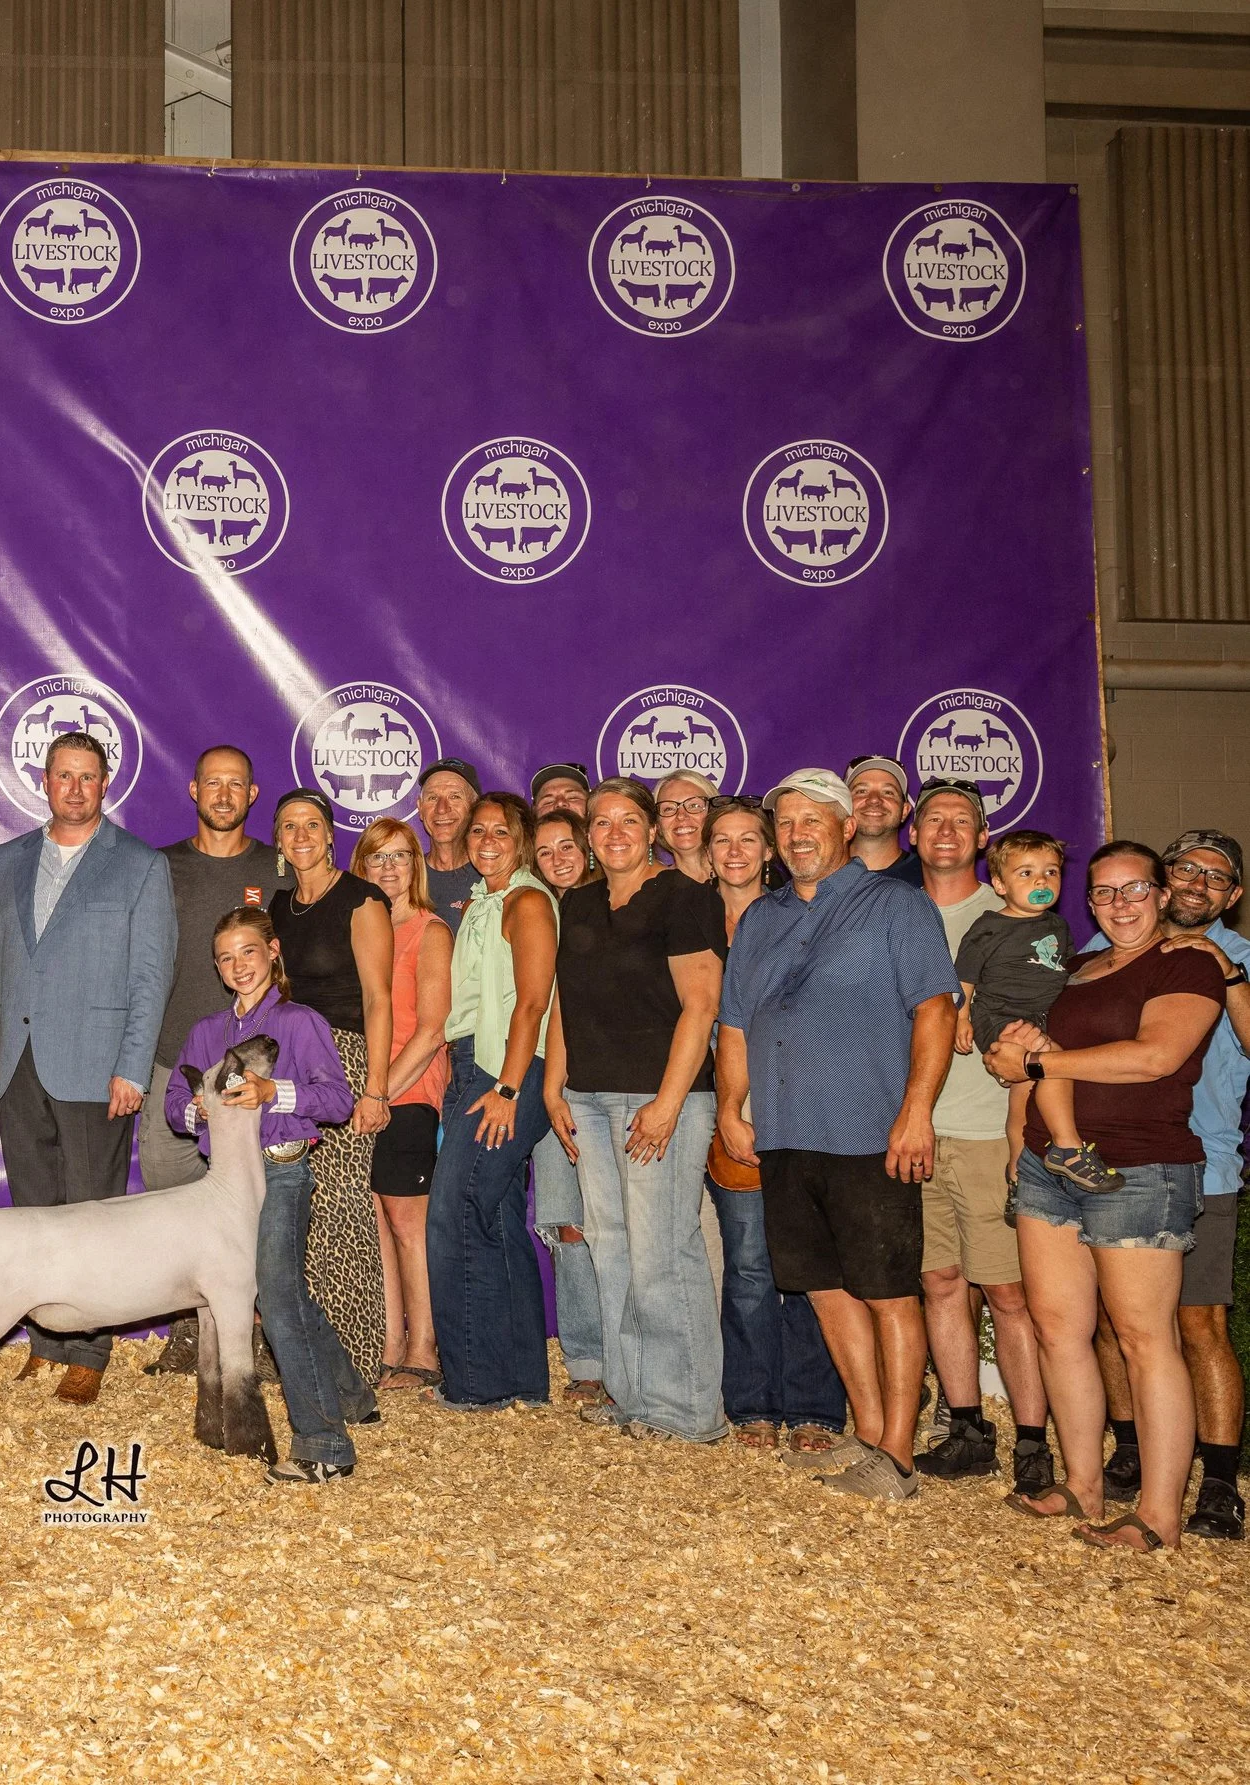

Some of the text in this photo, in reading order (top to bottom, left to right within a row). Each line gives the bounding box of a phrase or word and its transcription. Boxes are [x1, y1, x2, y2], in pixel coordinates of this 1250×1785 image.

[37, 183, 99, 202] michigan
[334, 192, 396, 211] michigan
[630, 200, 693, 217] michigan
[924, 204, 987, 221] michigan
[15, 244, 117, 261] LIVESTOCK
[313, 254, 414, 270] LIVESTOCK
[611, 260, 712, 276] LIVESTOCK
[907, 263, 1005, 280] LIVESTOCK
[50, 307, 84, 320] expo
[349, 317, 382, 329] expo
[648, 321, 681, 333] expo
[943, 325, 975, 337] expo
[186, 434, 248, 453] michigan
[485, 441, 548, 459] michigan
[785, 444, 847, 462] michigan
[165, 494, 267, 514] LIVESTOCK
[465, 503, 567, 519] LIVESTOCK
[766, 505, 866, 522] LIVESTOCK
[501, 567, 535, 579] expo
[803, 569, 835, 582] expo
[337, 686, 399, 705] michigan
[641, 689, 703, 708] michigan
[939, 693, 1001, 711] michigan
[314, 749, 418, 766] LIVESTOCK
[620, 752, 724, 768] LIVESTOCK
[920, 755, 1020, 772] LIVESTOCK
